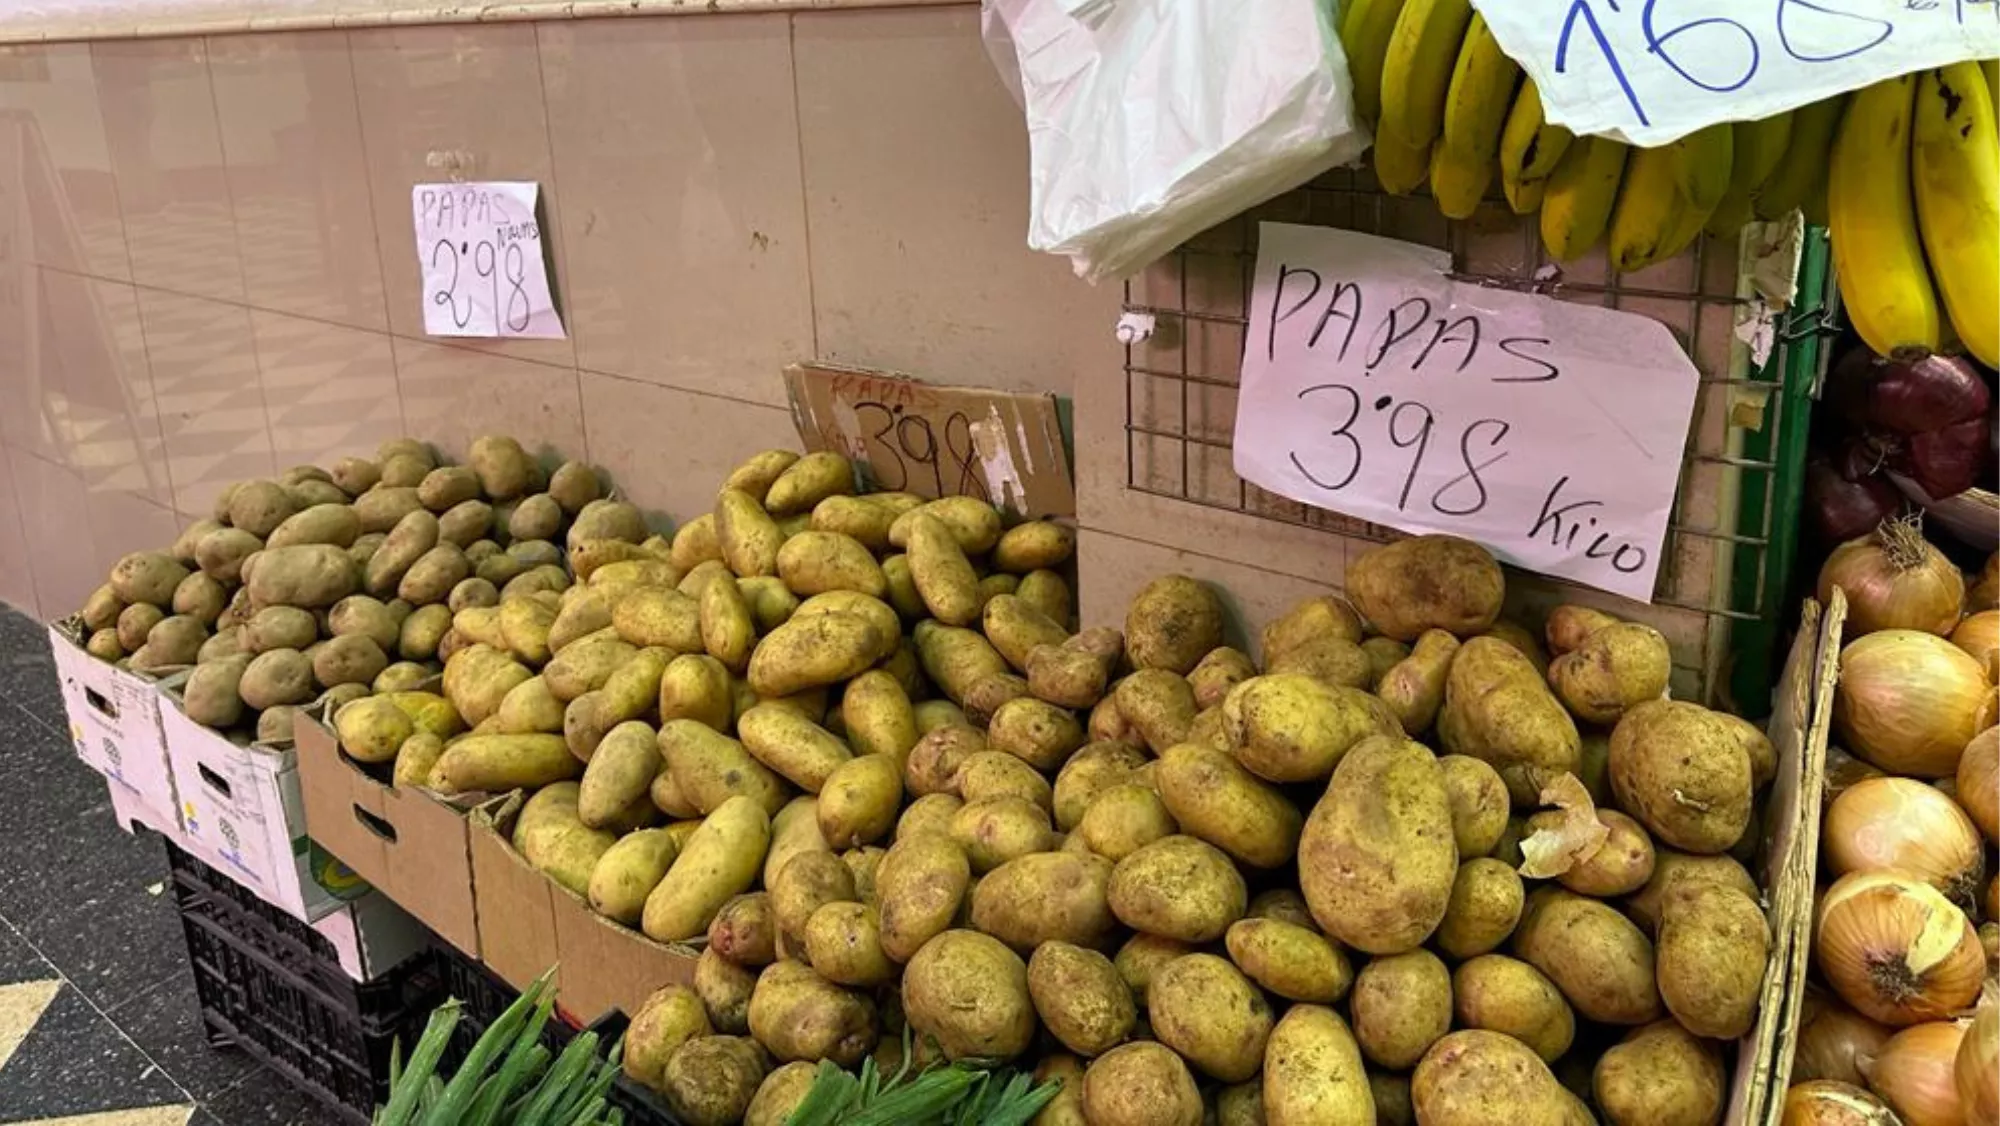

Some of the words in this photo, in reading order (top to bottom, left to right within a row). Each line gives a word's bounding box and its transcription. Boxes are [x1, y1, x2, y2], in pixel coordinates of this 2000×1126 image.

[421, 190, 510, 230] PAPAS
[433, 238, 530, 336] 2'98
[1268, 263, 1560, 383] PAPAS
[1289, 384, 1511, 516] 3'98
